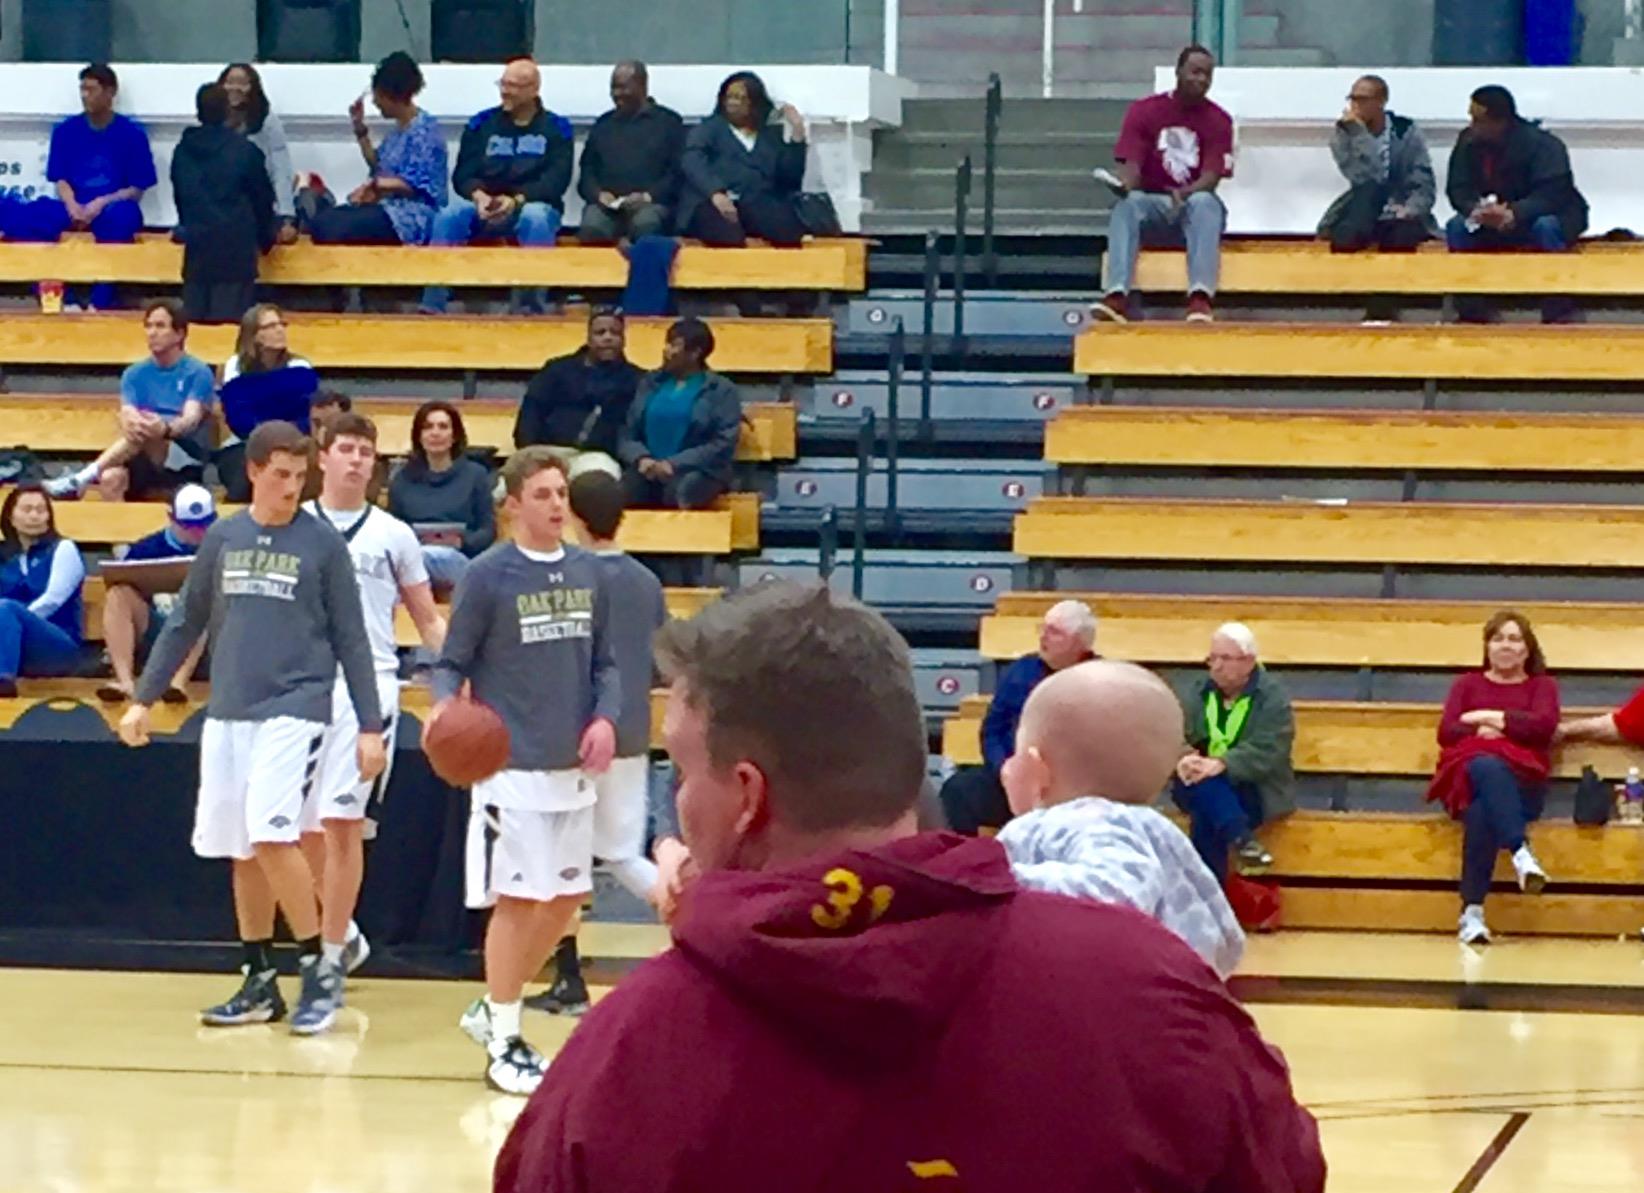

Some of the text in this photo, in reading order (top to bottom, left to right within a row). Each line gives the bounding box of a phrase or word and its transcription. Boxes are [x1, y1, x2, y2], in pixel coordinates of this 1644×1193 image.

[256, 550, 301, 576] PARK
[516, 588, 592, 616] OAK PARK
